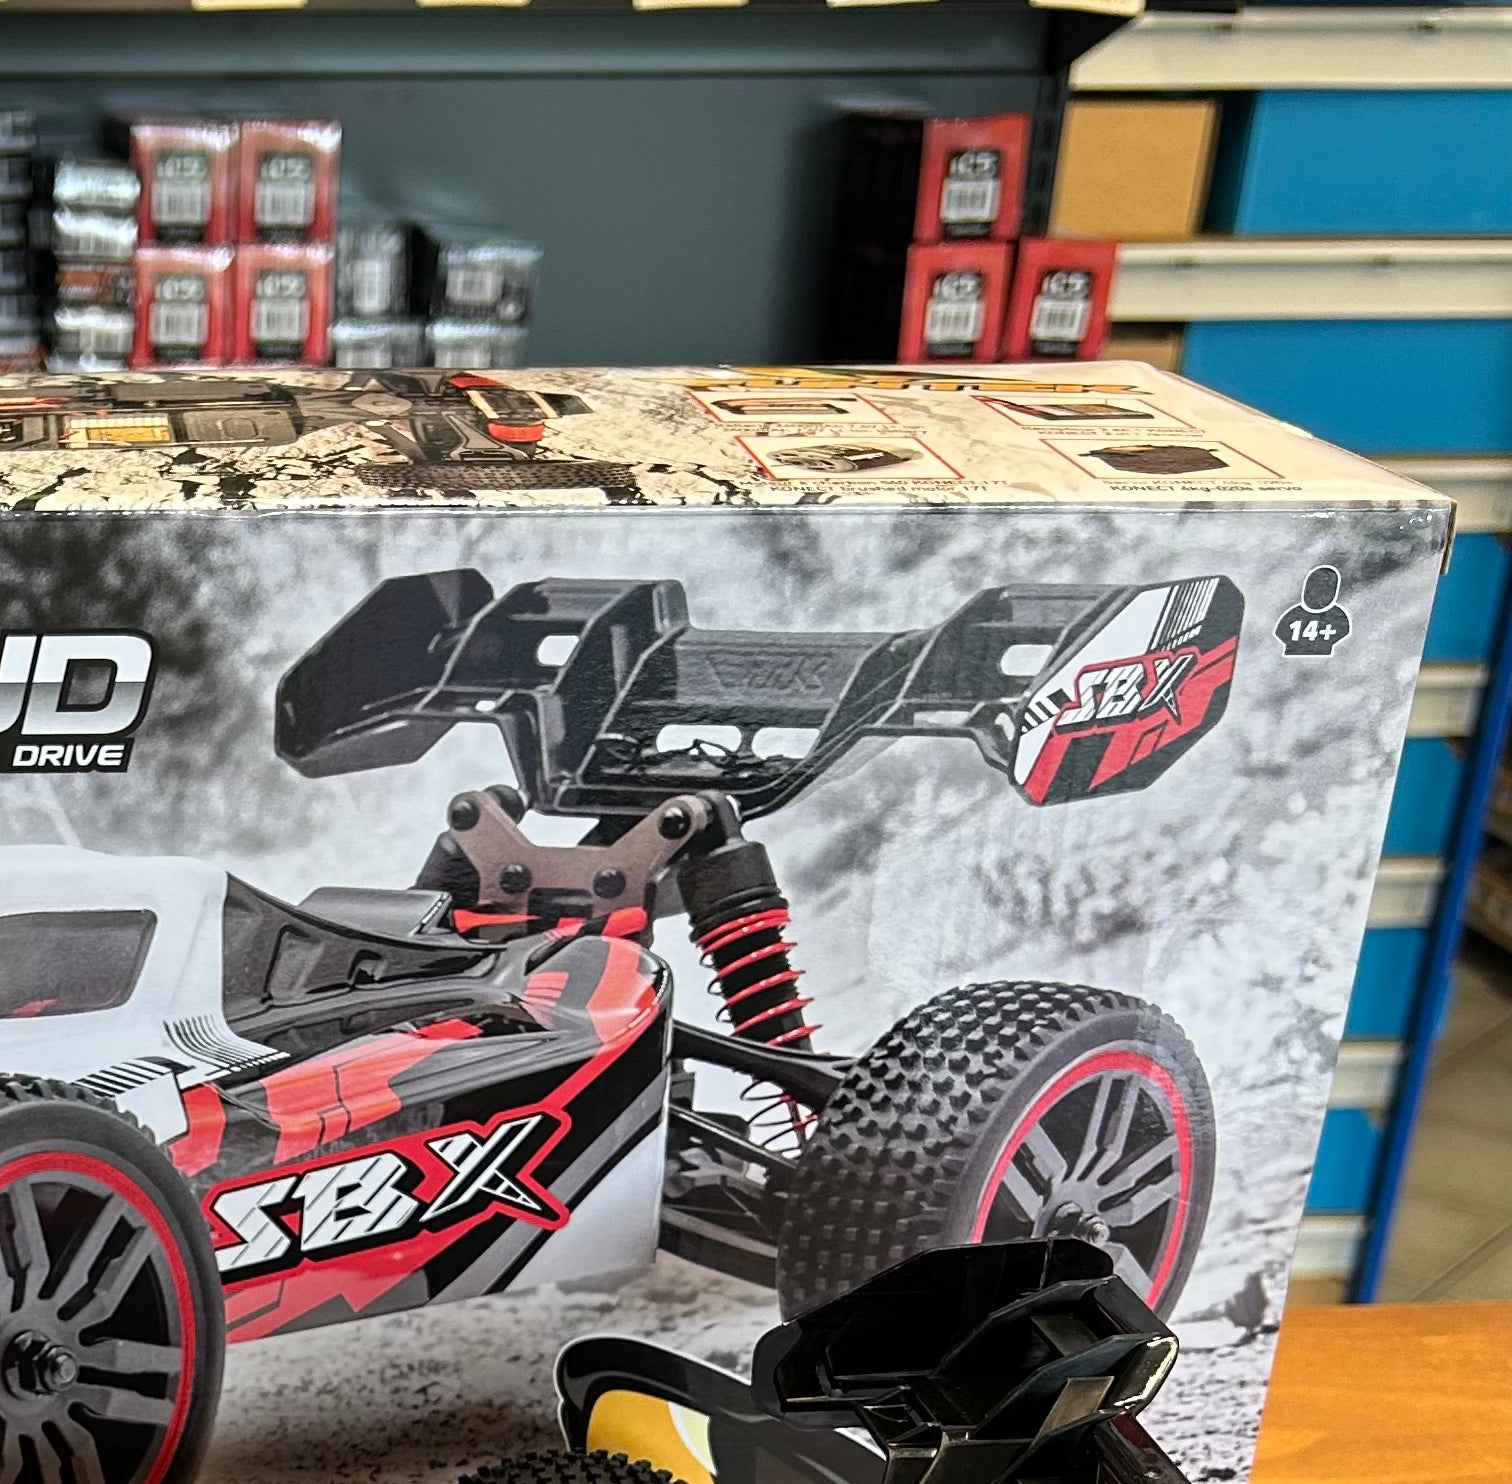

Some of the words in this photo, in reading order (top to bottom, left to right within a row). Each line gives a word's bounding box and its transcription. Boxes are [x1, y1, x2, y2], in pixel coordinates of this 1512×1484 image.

[1288, 619, 1338, 642] 14+
[1054, 652, 1195, 727] SBX
[10, 742, 126, 768] DRIVE
[211, 1114, 554, 1274] SBX
